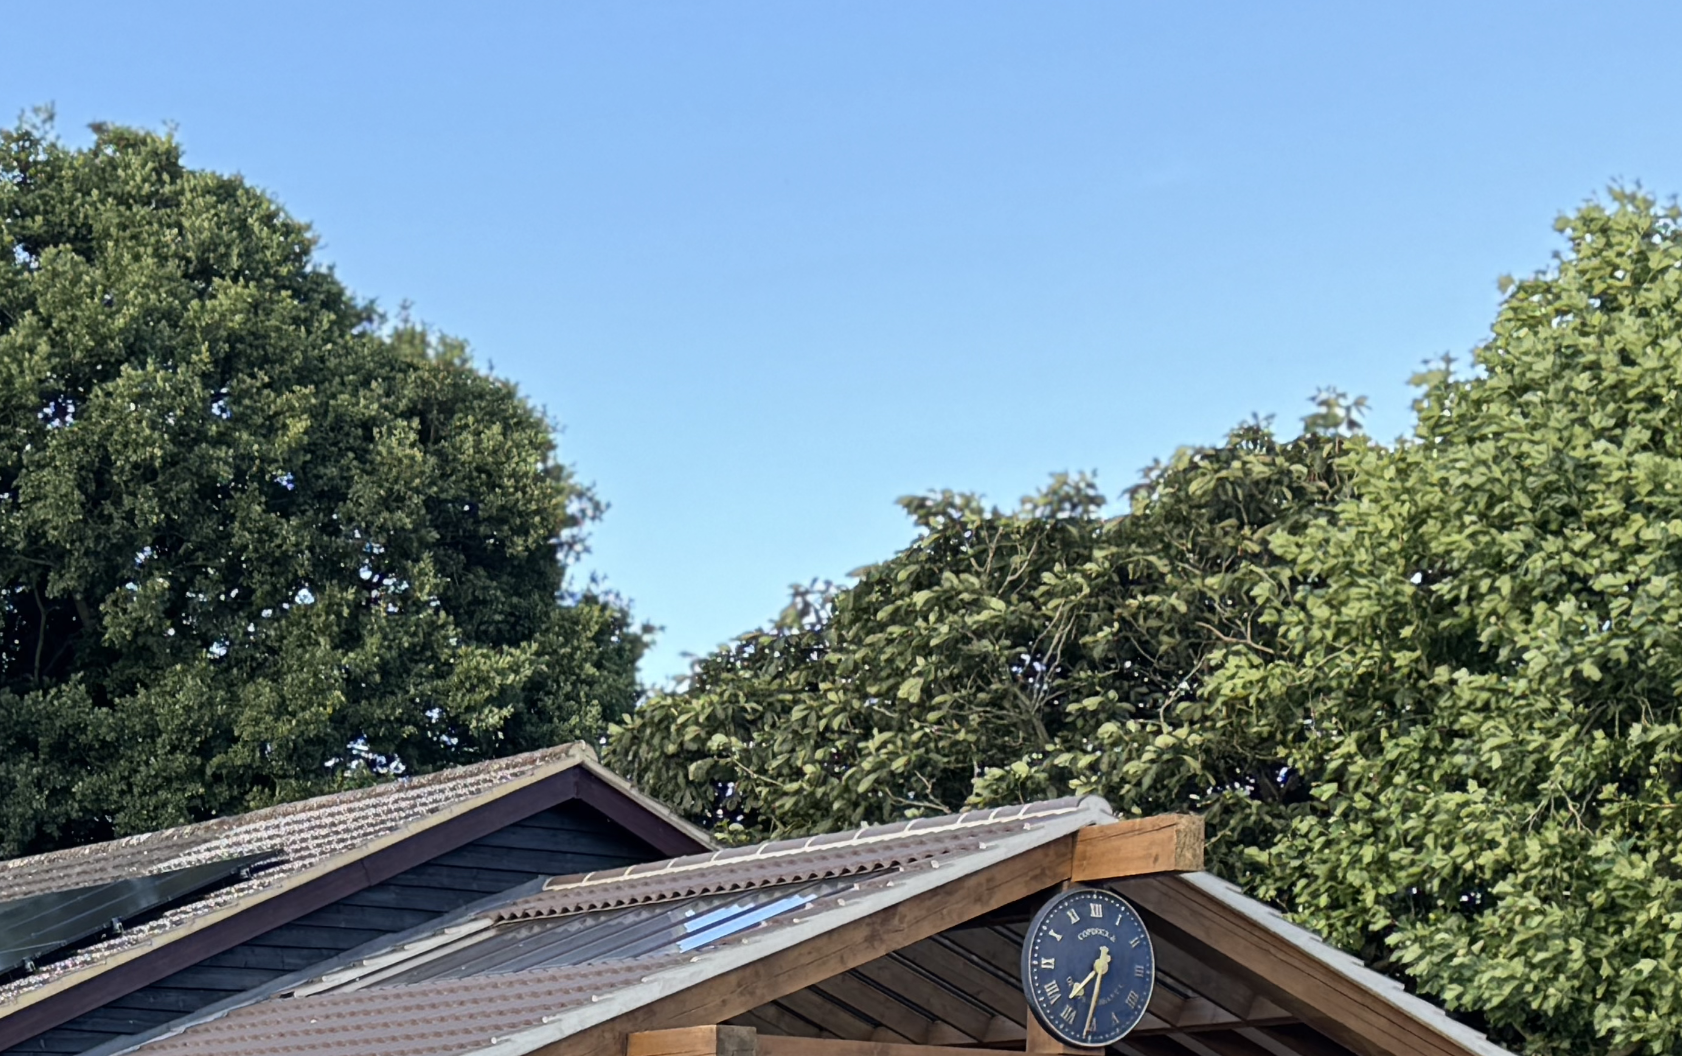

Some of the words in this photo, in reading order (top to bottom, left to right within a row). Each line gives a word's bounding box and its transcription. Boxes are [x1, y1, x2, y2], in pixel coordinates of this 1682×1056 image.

[1089, 903, 1103, 918] XII
[1115, 914, 1122, 926] I
[1128, 936, 1141, 949] II
[1134, 964, 1145, 978] III
[1043, 979, 1062, 1006] VIII
[1060, 1004, 1077, 1025] VII
